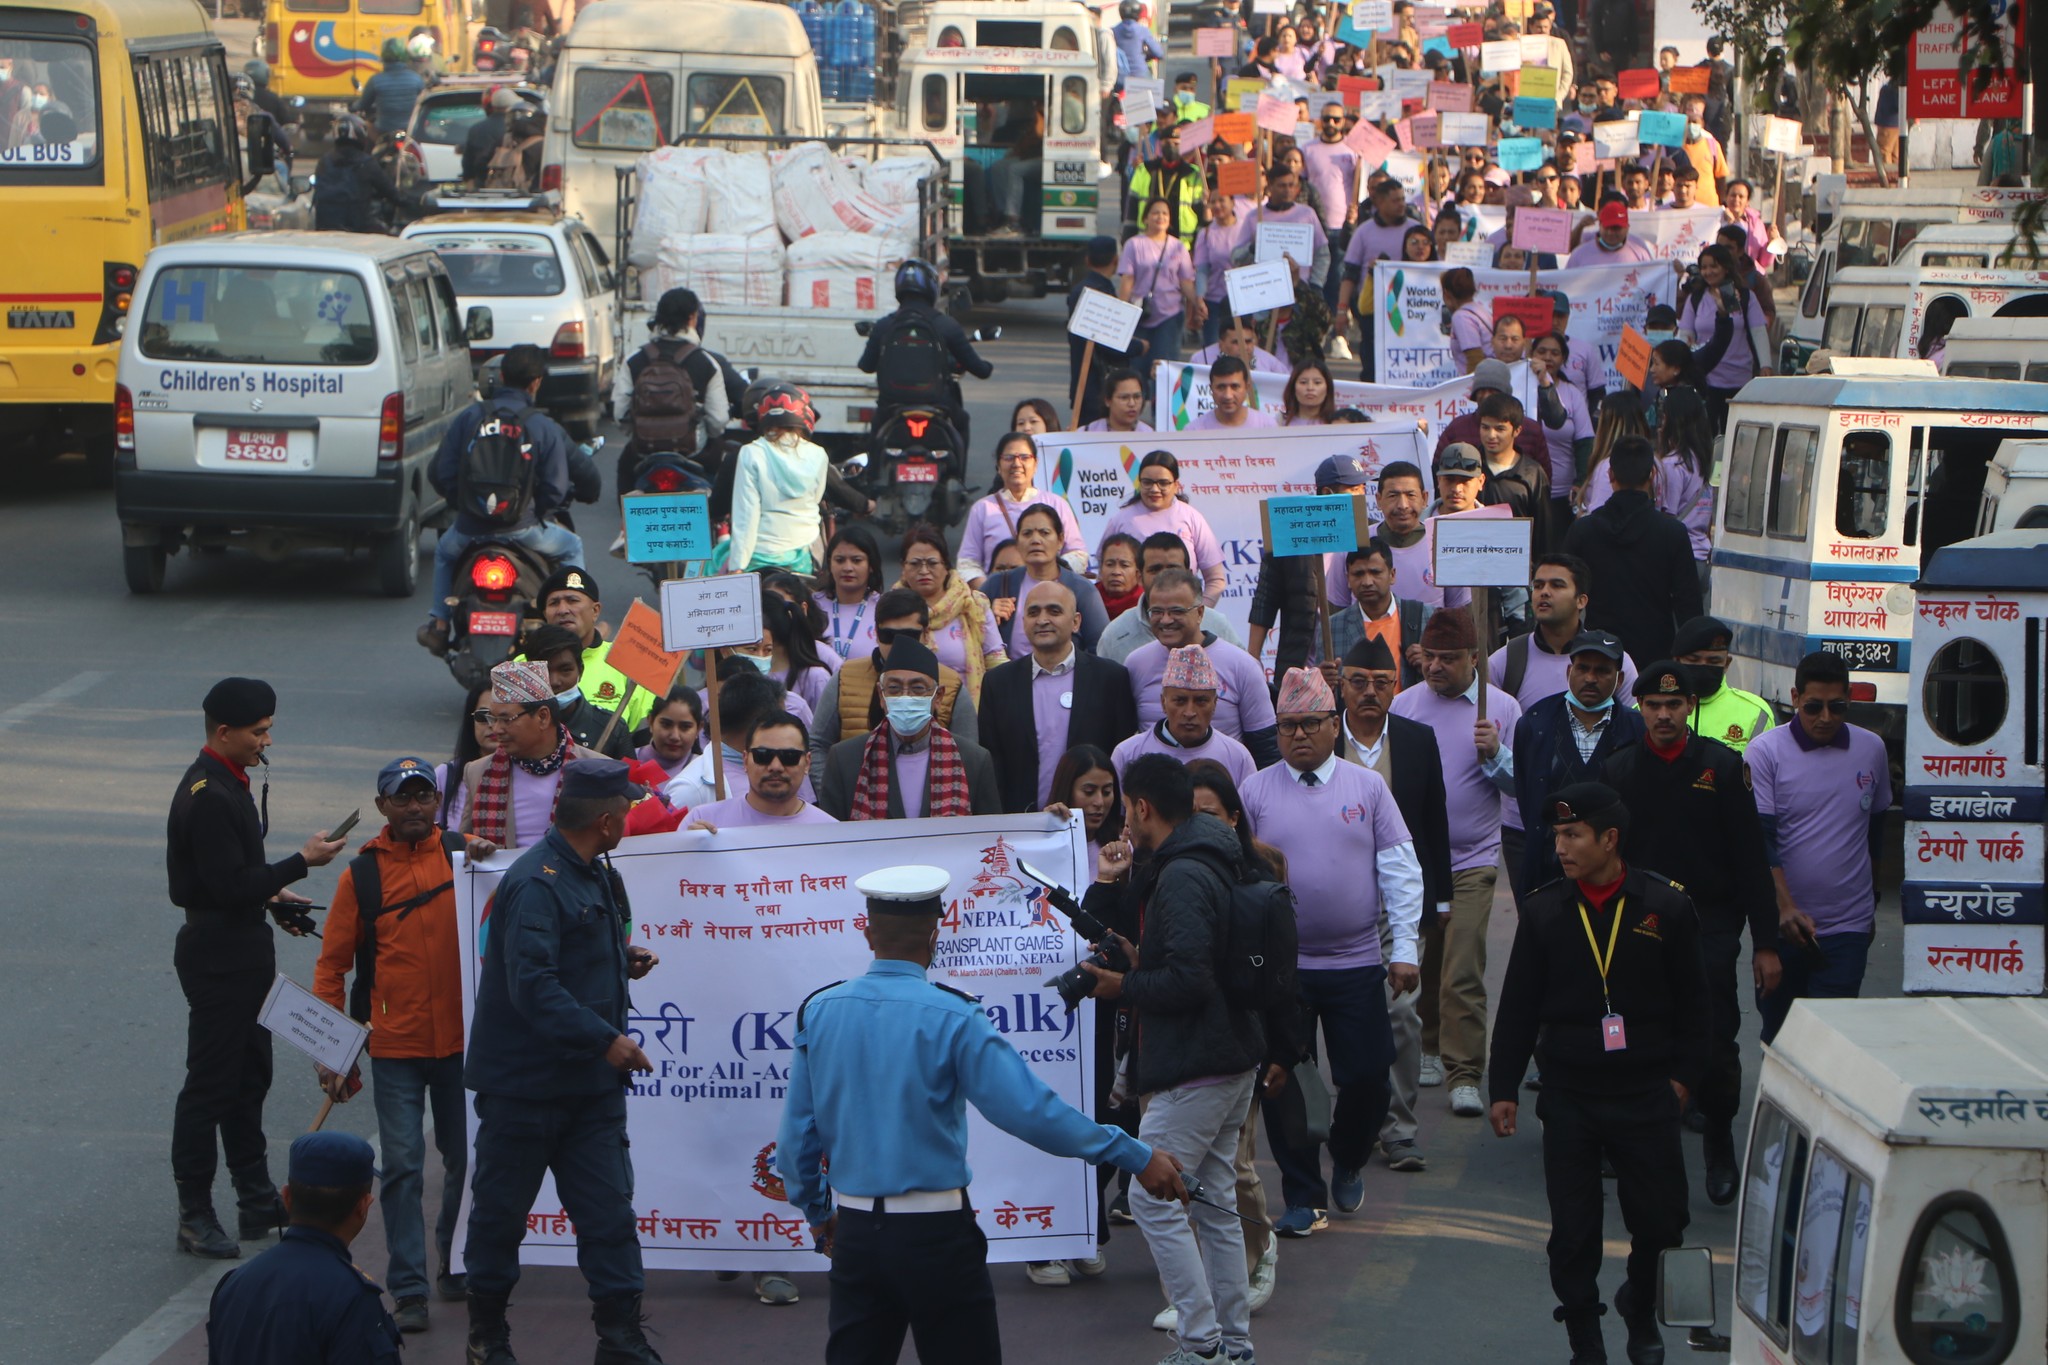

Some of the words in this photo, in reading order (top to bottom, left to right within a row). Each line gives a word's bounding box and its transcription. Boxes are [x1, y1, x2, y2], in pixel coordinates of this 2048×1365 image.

[1923, 79, 1955, 89] LEFT
[1923, 94, 1956, 105] LANE
[33, 143, 72, 161] BUS
[1406, 286, 1437, 296] World
[162, 279, 206, 323] H
[1407, 298, 1441, 310] Kidney
[10, 312, 74, 328] TATA
[1407, 309, 1426, 321] Day
[718, 331, 816, 358] TATA
[1388, 370, 1427, 381] Kidney
[1431, 368, 1459, 379] Heal
[160, 369, 256, 391] Children's
[263, 372, 344, 398] Hospital
[1840, 411, 1904, 428] इमाडोल
[227, 444, 287, 461] ३६२०
[1204, 454, 1242, 472] मृगौला
[1245, 454, 1276, 468] दिवस
[1077, 468, 1118, 484] World
[1219, 472, 1236, 480] तथा
[1080, 484, 1126, 500] Kidney
[1191, 482, 1220, 495] नेपाल
[630, 507, 658, 517] महादान
[660, 506, 678, 518] पुण्य
[1082, 499, 1108, 515] Day
[1274, 505, 1303, 515] महादान
[1305, 504, 1323, 517] पुण्य
[661, 523, 676, 532] दान
[1305, 520, 1321, 529] दान
[714, 590, 729, 599] दान
[687, 608, 725, 619] अभियानमा
[1823, 606, 1888, 632] थापाथली
[1918, 600, 1972, 630] स्कूल
[1974, 595, 2020, 622] चोक
[1929, 791, 2017, 819] इमाडोल
[1917, 830, 1969, 863] टेम्पो
[1976, 831, 2025, 863] पार्क
[679, 878, 726, 898] विश्व
[734, 875, 794, 902] मृगौला
[800, 873, 848, 893] दिवस
[755, 904, 782, 917] तथा
[1923, 883, 2024, 921] न्यूरोड
[940, 897, 975, 934] 4th
[962, 910, 1021, 929] NEPAL
[640, 918, 694, 940] १४औं
[703, 920, 753, 940] नेपाल
[761, 916, 845, 940] प्रत्यारोपण
[936, 936, 1012, 955] RANSPLANT
[1014, 934, 1064, 951] GAMES
[930, 954, 1018, 970] KATHMANDU,
[1024, 952, 1065, 965] NEPAL
[1927, 939, 2024, 975] रत्नपार्क
[960, 968, 980, 977] March
[981, 968, 994, 976] 2024
[1025, 966, 1042, 976] 2080)
[320, 1016, 335, 1028] दान
[974, 993, 1075, 1042] alk)
[1019, 1048, 1076, 1063] ccess
[659, 1060, 703, 1079] For
[708, 1061, 744, 1080] All
[670, 1081, 761, 1103] optimal
[993, 1200, 1055, 1231] केन्द्र
[636, 1209, 721, 1241] र्मभक्त
[735, 1211, 804, 1248] राष्ट्रि
